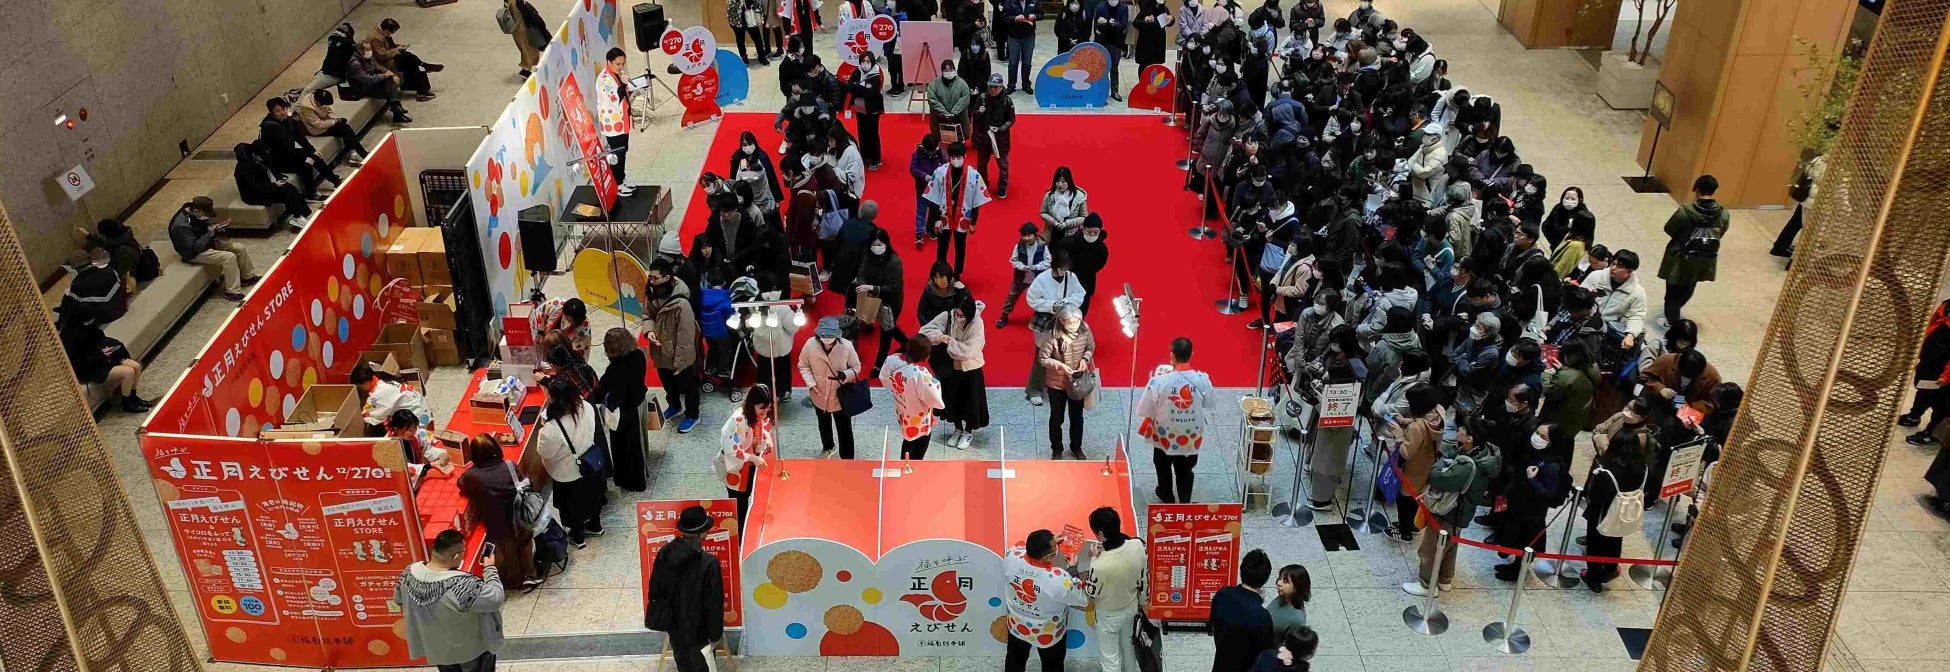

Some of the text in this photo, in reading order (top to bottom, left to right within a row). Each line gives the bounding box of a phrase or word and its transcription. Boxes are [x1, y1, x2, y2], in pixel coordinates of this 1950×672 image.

[211, 315, 264, 387] 正月えびせん
[264, 280, 294, 320] STORE
[190, 460, 334, 480] 正月えびせん
[179, 513, 241, 524] 正月えびせん
[333, 518, 399, 527] 正月えびせん
[1164, 513, 1218, 522] 正月えびせん
[184, 529, 230, 537] サイコロをふって
[915, 555, 968, 571] 福を呼ぶ
[909, 576, 973, 590] 正月
[243, 603, 262, 611] 100
[910, 622, 973, 632] えびせん
